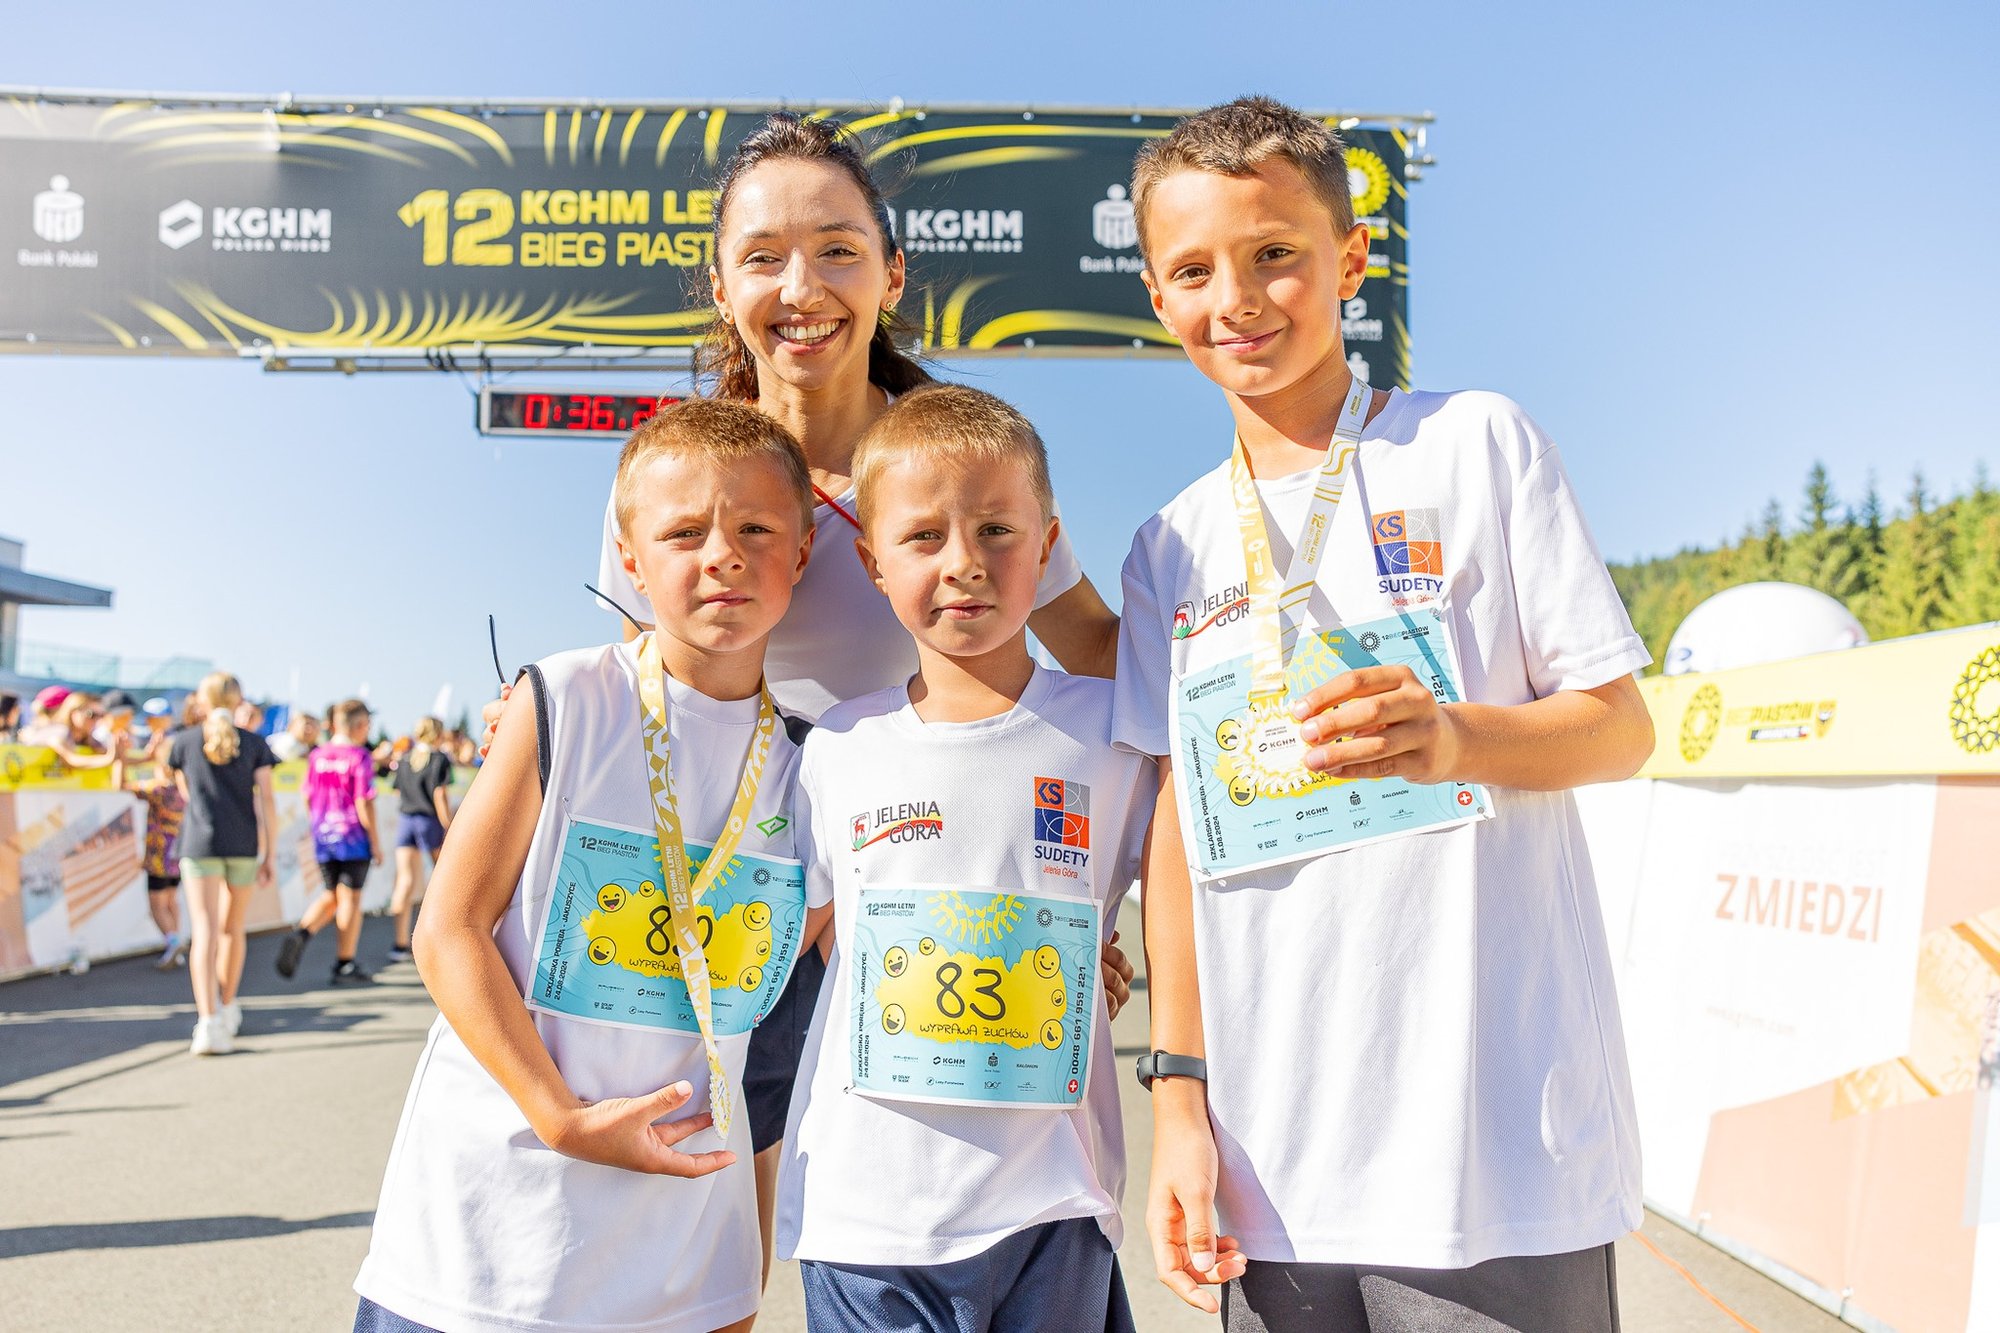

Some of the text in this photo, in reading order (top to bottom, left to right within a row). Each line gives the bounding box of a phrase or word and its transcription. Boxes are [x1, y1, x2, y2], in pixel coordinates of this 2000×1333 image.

[520, 190, 720, 224] KGHM LE
[212, 207, 331, 238] KGHM
[397, 188, 514, 266] 12
[905, 209, 1024, 240] KGHM
[520, 232, 716, 267] BIEG PIAST
[524, 393, 681, 431] 0:36.2
[1376, 515, 1404, 538] KS
[1379, 577, 1443, 594] SUDETY
[1201, 581, 1249, 618] JELENI
[1215, 599, 1250, 628] GÓR
[1185, 686, 1200, 702] 12
[1431, 674, 1446, 697] 221
[1269, 737, 1296, 748] KGHM
[1190, 736, 1203, 779] JAKUSZYCE
[1038, 782, 1062, 805] KS
[874, 801, 941, 828] JELENIA
[1305, 806, 1328, 817] KGHM
[579, 836, 597, 851] 12
[889, 821, 941, 844] GÓRA
[1204, 817, 1218, 861] SZKLARSKA
[1213, 815, 1226, 859] 24.08.2024
[598, 839, 640, 853] KGHM LETNI
[1034, 845, 1089, 868] SUDETY
[665, 846, 679, 893] KGHM LETNI
[1042, 865, 1078, 879] Jelenia Góra
[673, 893, 689, 914] 12
[866, 903, 880, 916] 12
[545, 958, 559, 998] SZKLARSKA
[562, 882, 576, 922] JAKUSZYCE
[629, 958, 680, 973] WYPRAWA
[761, 921, 795, 1010] 0048 661 959 221
[554, 961, 568, 1000] 24.08.2024
[936, 962, 1006, 1021] 83
[646, 990, 665, 998] KGHM
[920, 1022, 1029, 1040] WYPRAWA ŻUCHÓW
[1071, 966, 1086, 1075] 0048 661 959 221
[942, 1057, 966, 1066] KGHM
